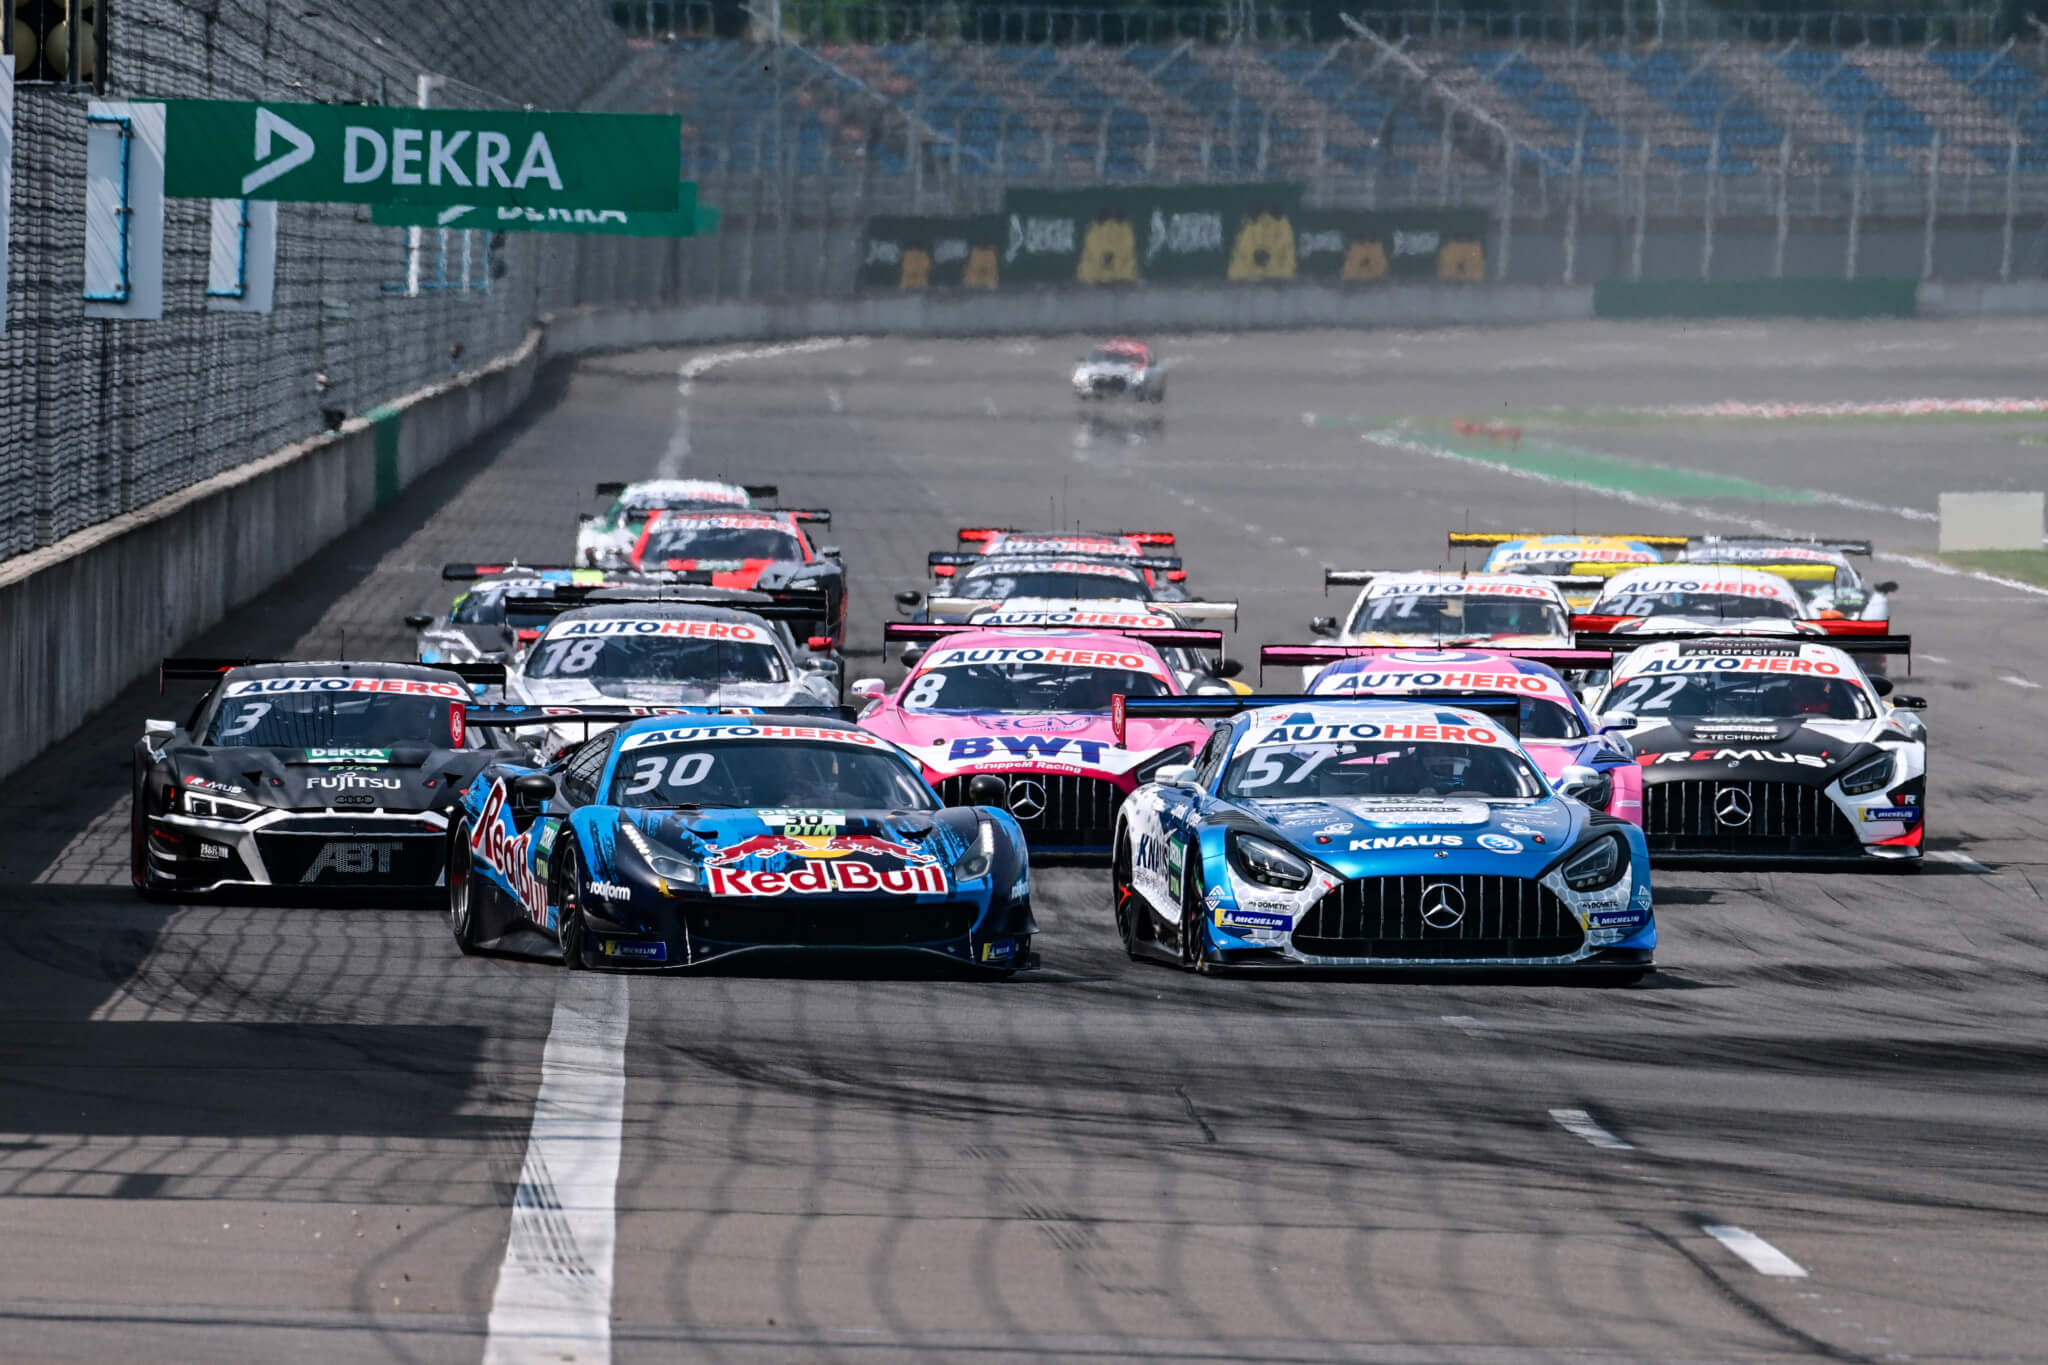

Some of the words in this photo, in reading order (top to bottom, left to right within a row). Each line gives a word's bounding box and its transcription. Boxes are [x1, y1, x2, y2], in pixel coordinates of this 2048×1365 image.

[343, 127, 564, 191] DEKRA
[1508, 550, 1652, 563] AUTOHERO
[1382, 583, 1548, 597] AUTOHERO
[1619, 580, 1779, 597] AUTOHERO
[983, 612, 1166, 627] AUTOHERO
[563, 621, 756, 640] AUTOHERO
[543, 638, 605, 674] 18
[941, 649, 1144, 669] AUTOHERO
[1685, 648, 1796, 658] #endracism
[1639, 657, 1841, 676] AUTOHERO
[235, 678, 461, 698] AUTOHERO
[903, 673, 947, 709] 8
[1334, 673, 1548, 693] AUTOHERO
[1606, 675, 1688, 712] 22
[220, 702, 272, 737] 3
[640, 726, 877, 747] AUTOHERO
[1259, 724, 1497, 744] AUTOHERO
[311, 748, 385, 757] DEKRA
[948, 736, 1110, 765] BWT
[1655, 749, 1828, 769] REMUS
[624, 753, 715, 796] 30
[974, 760, 1034, 771] GruppeM
[1036, 762, 1083, 774] Racing
[1238, 743, 1334, 789] 57
[306, 772, 401, 791] FUJITSU
[783, 824, 837, 837] DTM
[1350, 834, 1463, 851] KNAUS
[300, 842, 404, 883] ABT
[708, 861, 831, 895] Red
[831, 861, 949, 895] Bull
[1258, 902, 1291, 911] DOMETIC
[1235, 915, 1284, 926] MICHELIN
[1601, 915, 1641, 925] MICHELIN
